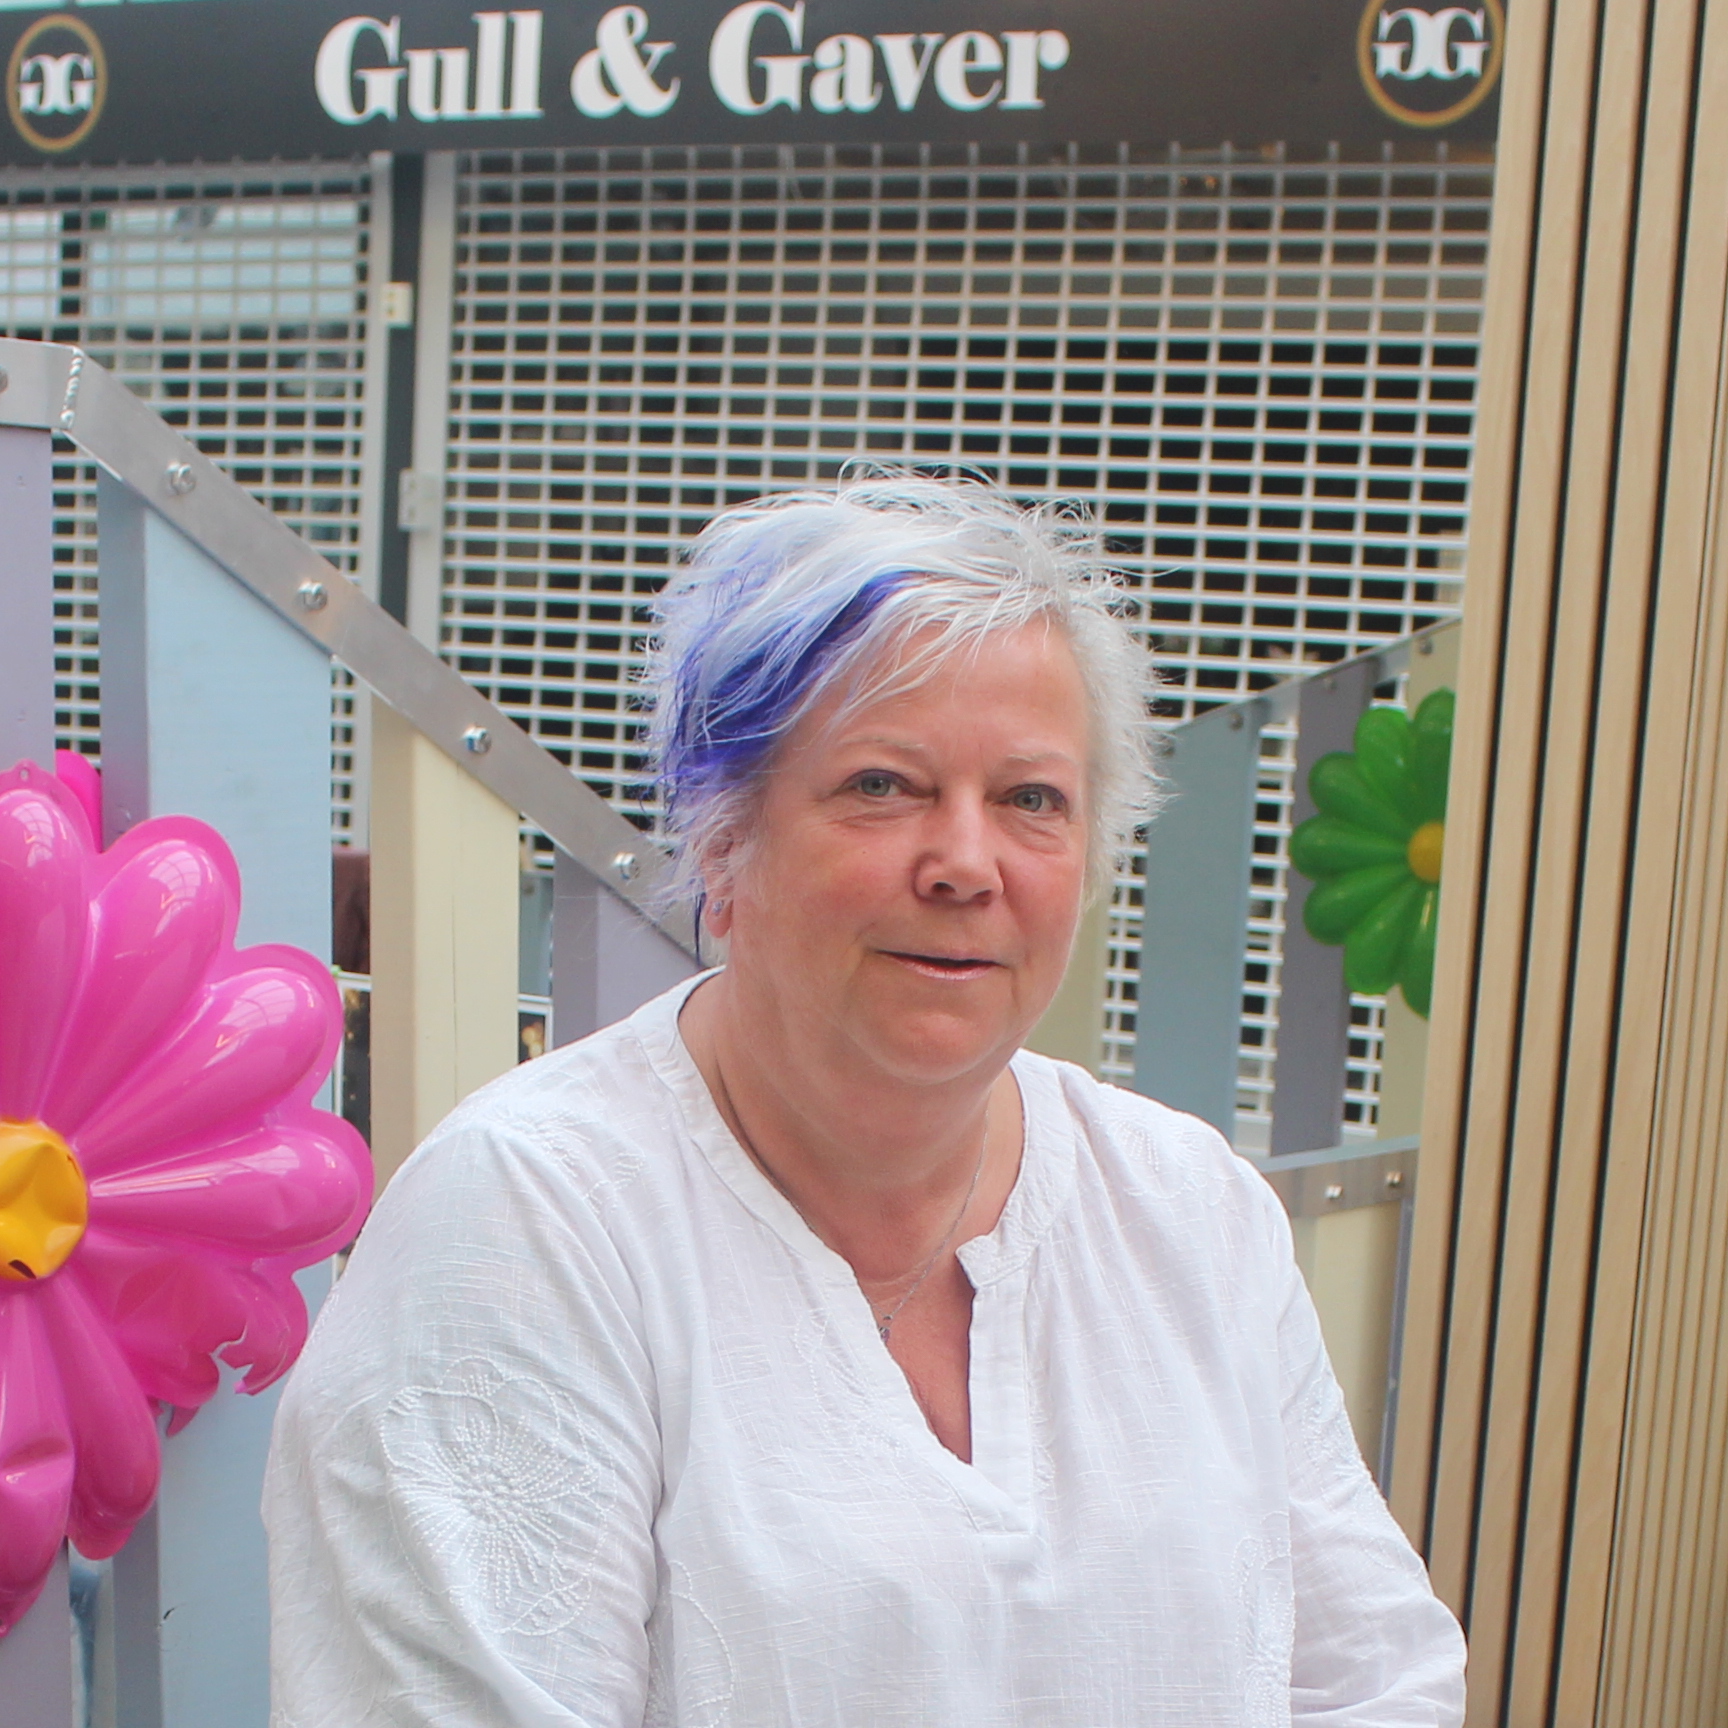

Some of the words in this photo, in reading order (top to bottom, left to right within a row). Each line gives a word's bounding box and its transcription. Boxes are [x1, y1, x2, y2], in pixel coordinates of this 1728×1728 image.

[314, 9, 544, 125] Gull
[570, 5, 681, 119] &
[707, 0, 1070, 116] Gaver
